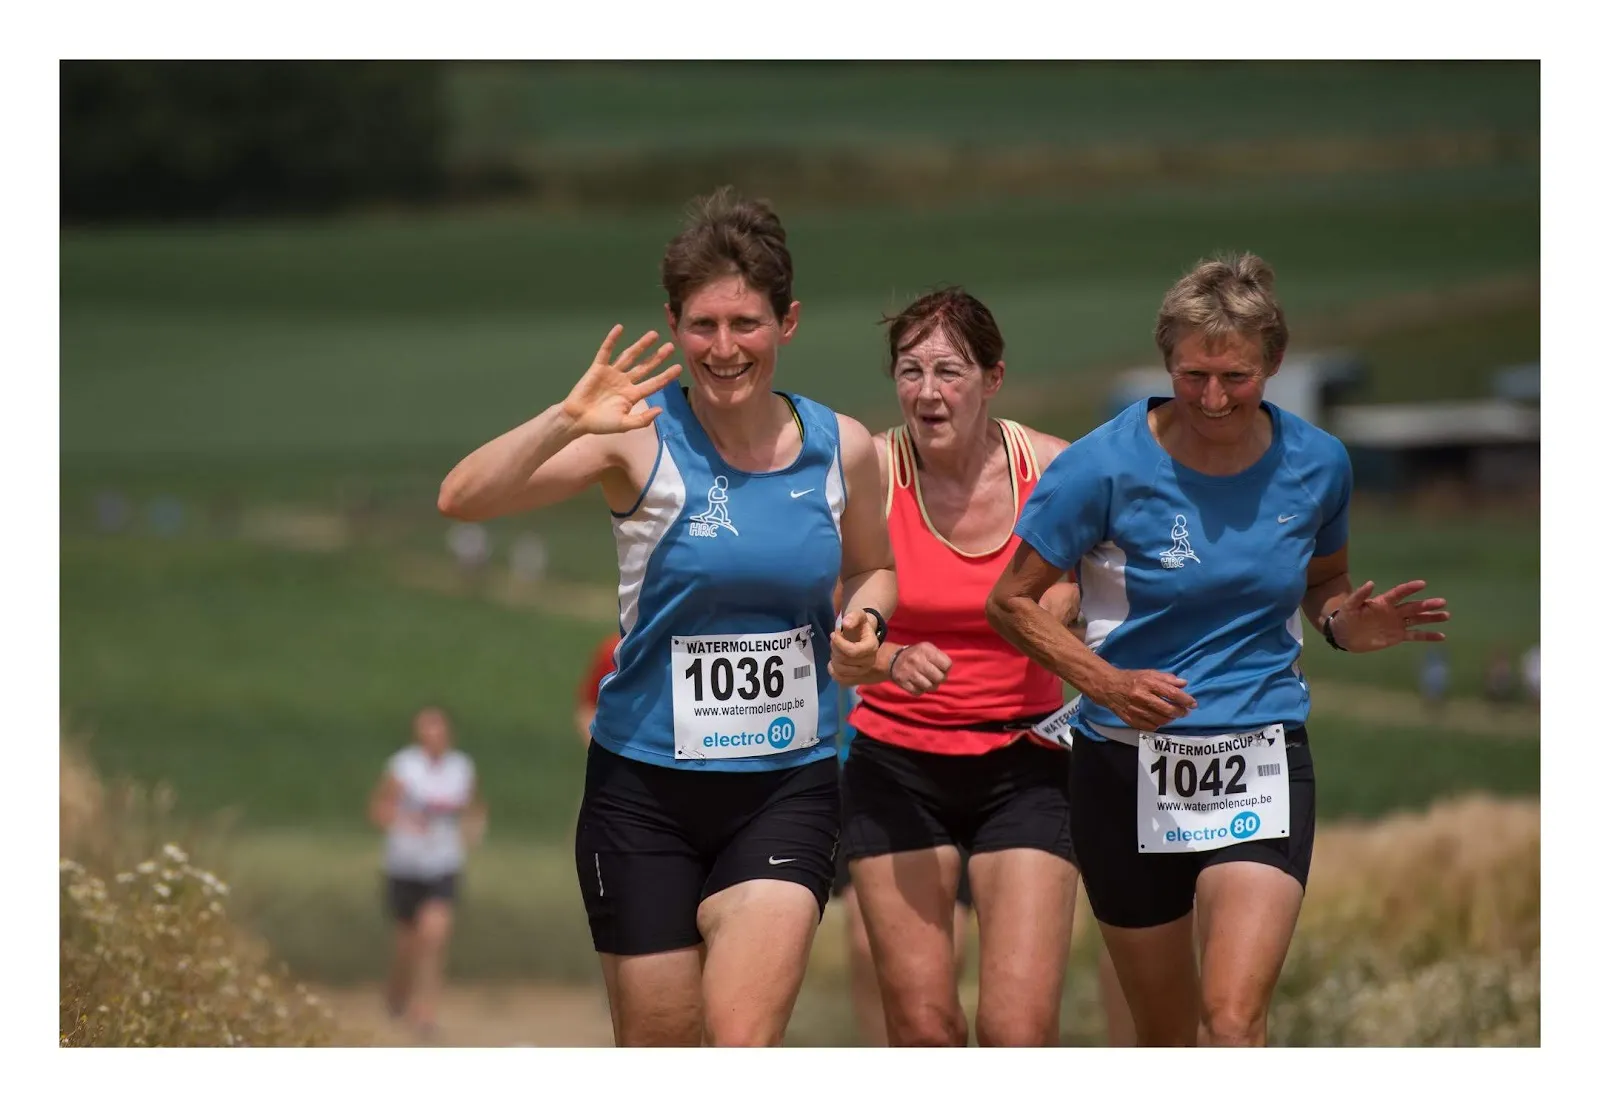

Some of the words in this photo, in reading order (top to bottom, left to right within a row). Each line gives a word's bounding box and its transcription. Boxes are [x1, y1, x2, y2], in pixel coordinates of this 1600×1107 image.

[689, 523, 719, 537] HRC
[1160, 556, 1185, 568] HRC
[687, 637, 792, 654] WATERMOLENCUP
[685, 655, 785, 701] 1036
[694, 698, 805, 716] www.watermolencup.be
[703, 732, 765, 747] electro
[771, 723, 792, 742] 80
[1154, 735, 1253, 756] WATERMOLENCUP
[1151, 754, 1247, 798] 1042
[1157, 794, 1272, 811] www.watermolencup.be
[1166, 827, 1228, 842] electro
[1234, 816, 1257, 834] 80
